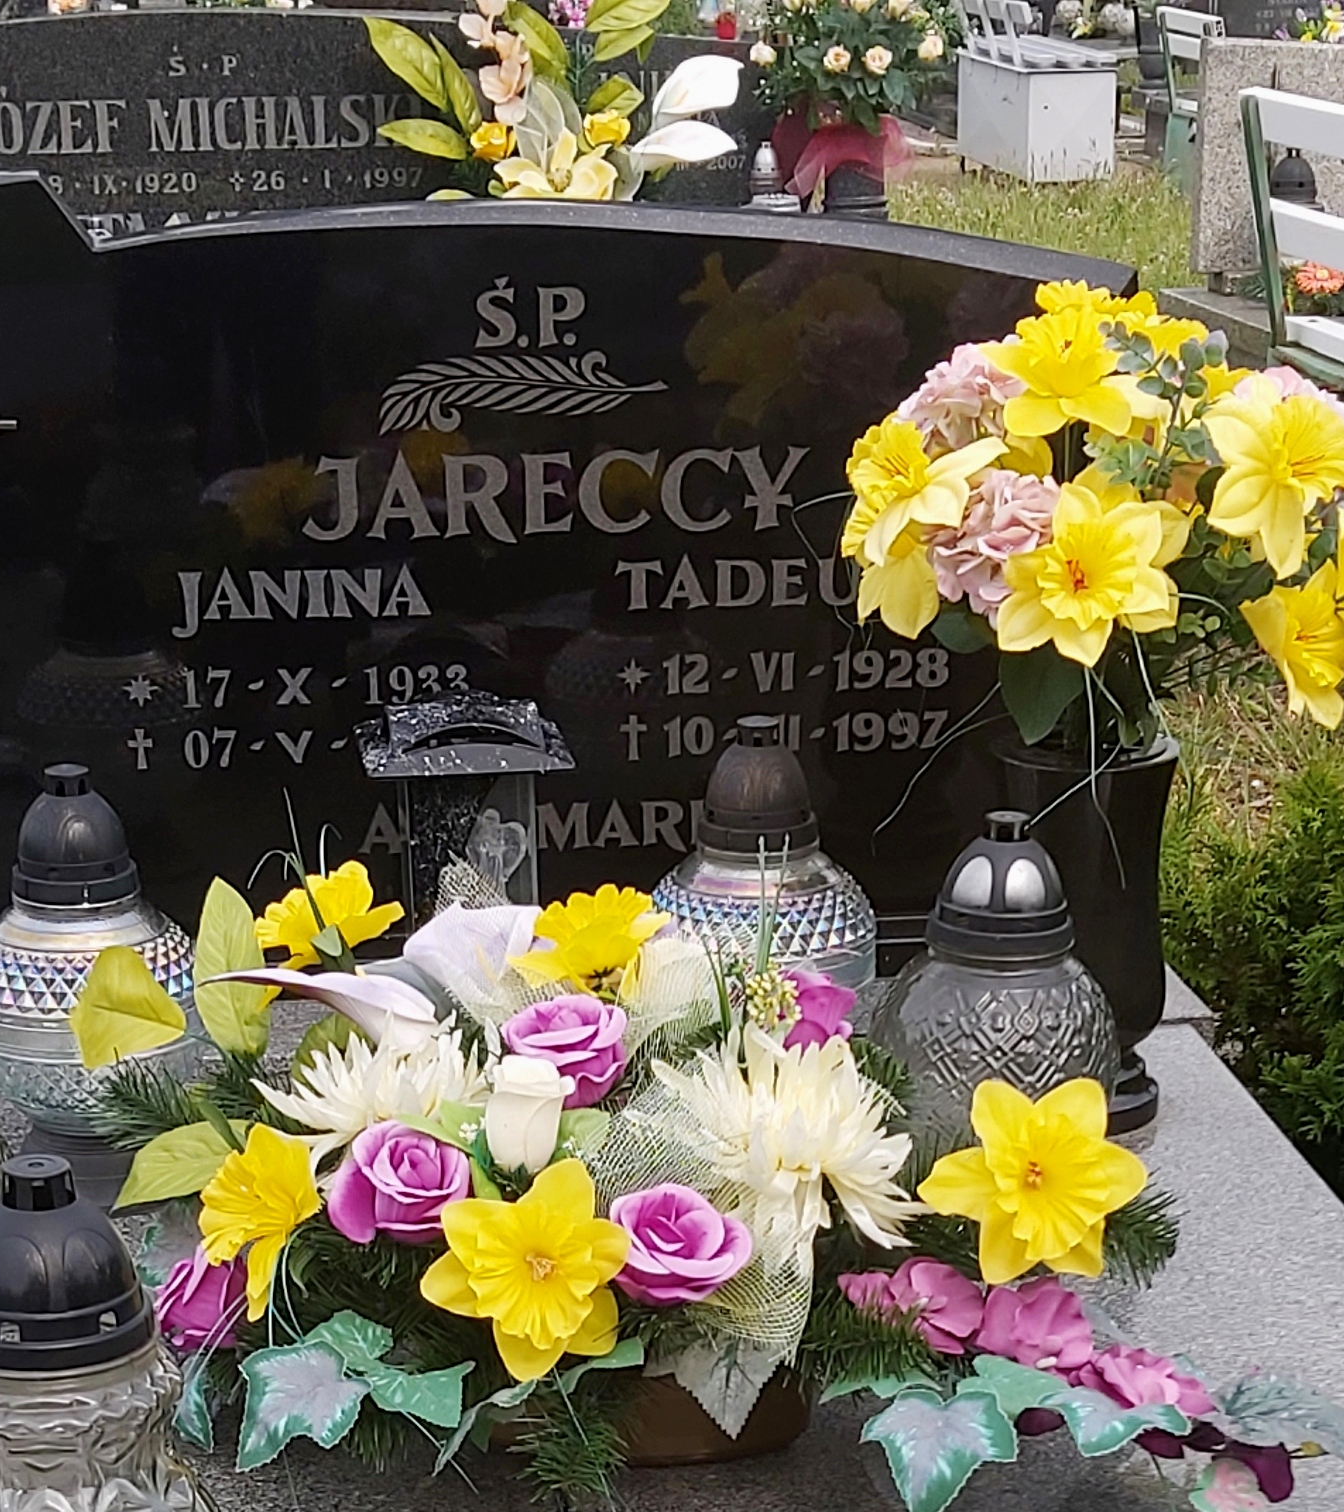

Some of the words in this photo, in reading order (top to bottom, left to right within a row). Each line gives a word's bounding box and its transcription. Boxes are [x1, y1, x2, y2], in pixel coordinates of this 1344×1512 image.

[302, 445, 810, 546] JARECCY
[172, 562, 433, 640] JANINA
[614, 552, 860, 612] TADEU
[536, 797, 704, 852] MARI
